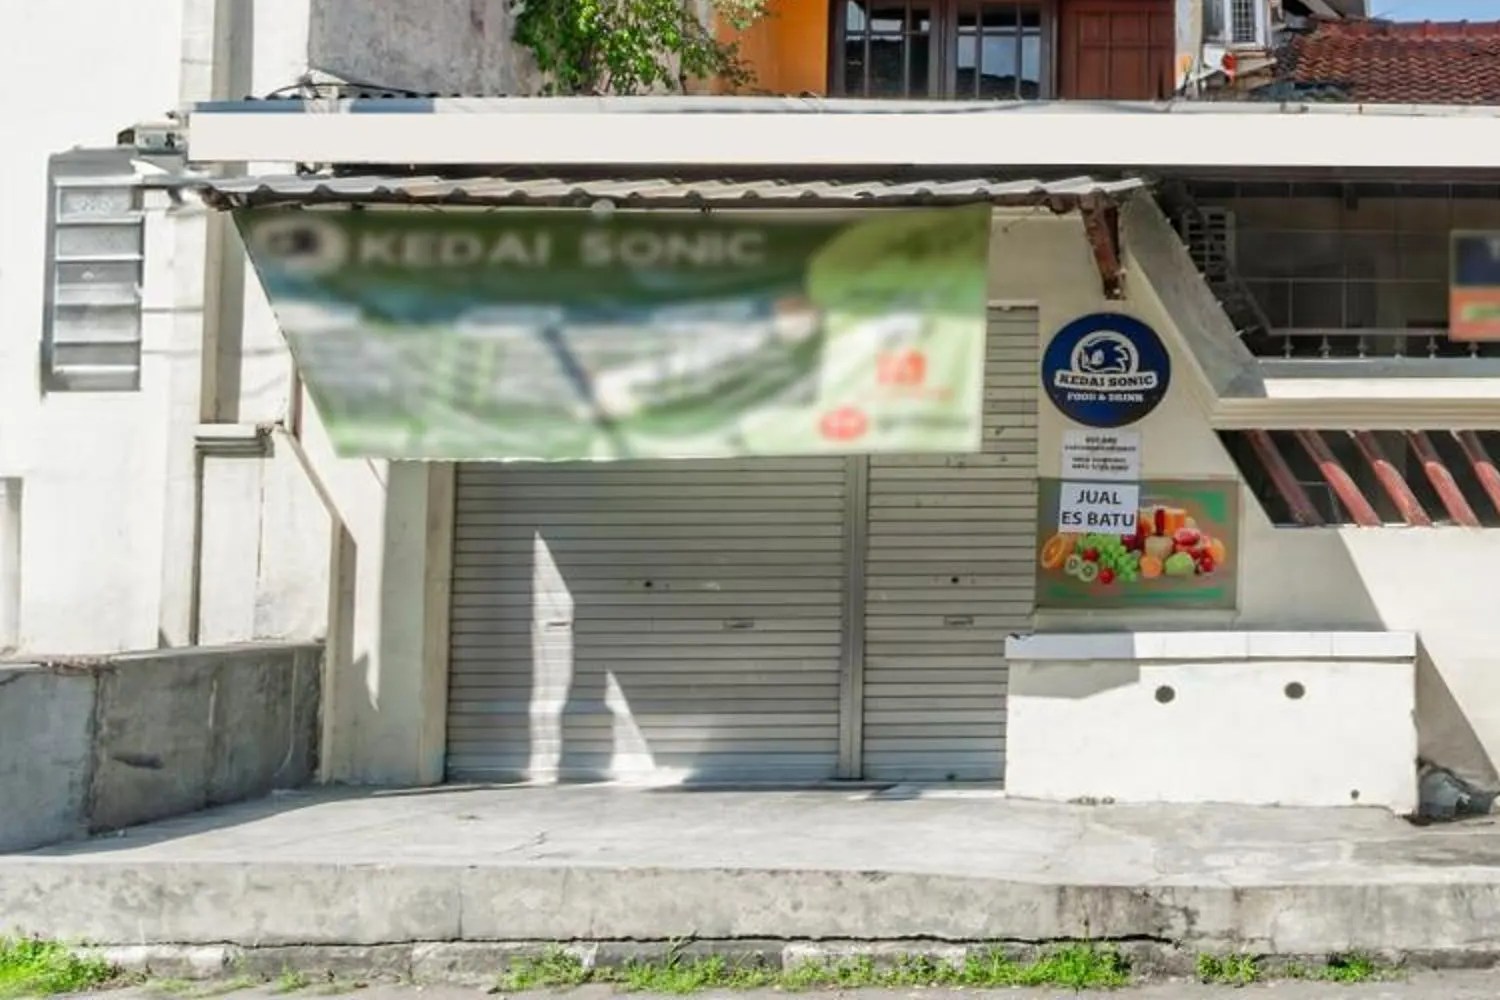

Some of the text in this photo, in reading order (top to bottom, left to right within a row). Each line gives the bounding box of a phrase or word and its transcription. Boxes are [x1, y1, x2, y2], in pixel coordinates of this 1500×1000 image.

[360, 230, 768, 269] KEDAI SONIC
[1059, 374, 1154, 387] KEDAI SONIC
[1076, 489, 1122, 505] JUAL
[1061, 511, 1135, 527] ES BATU
